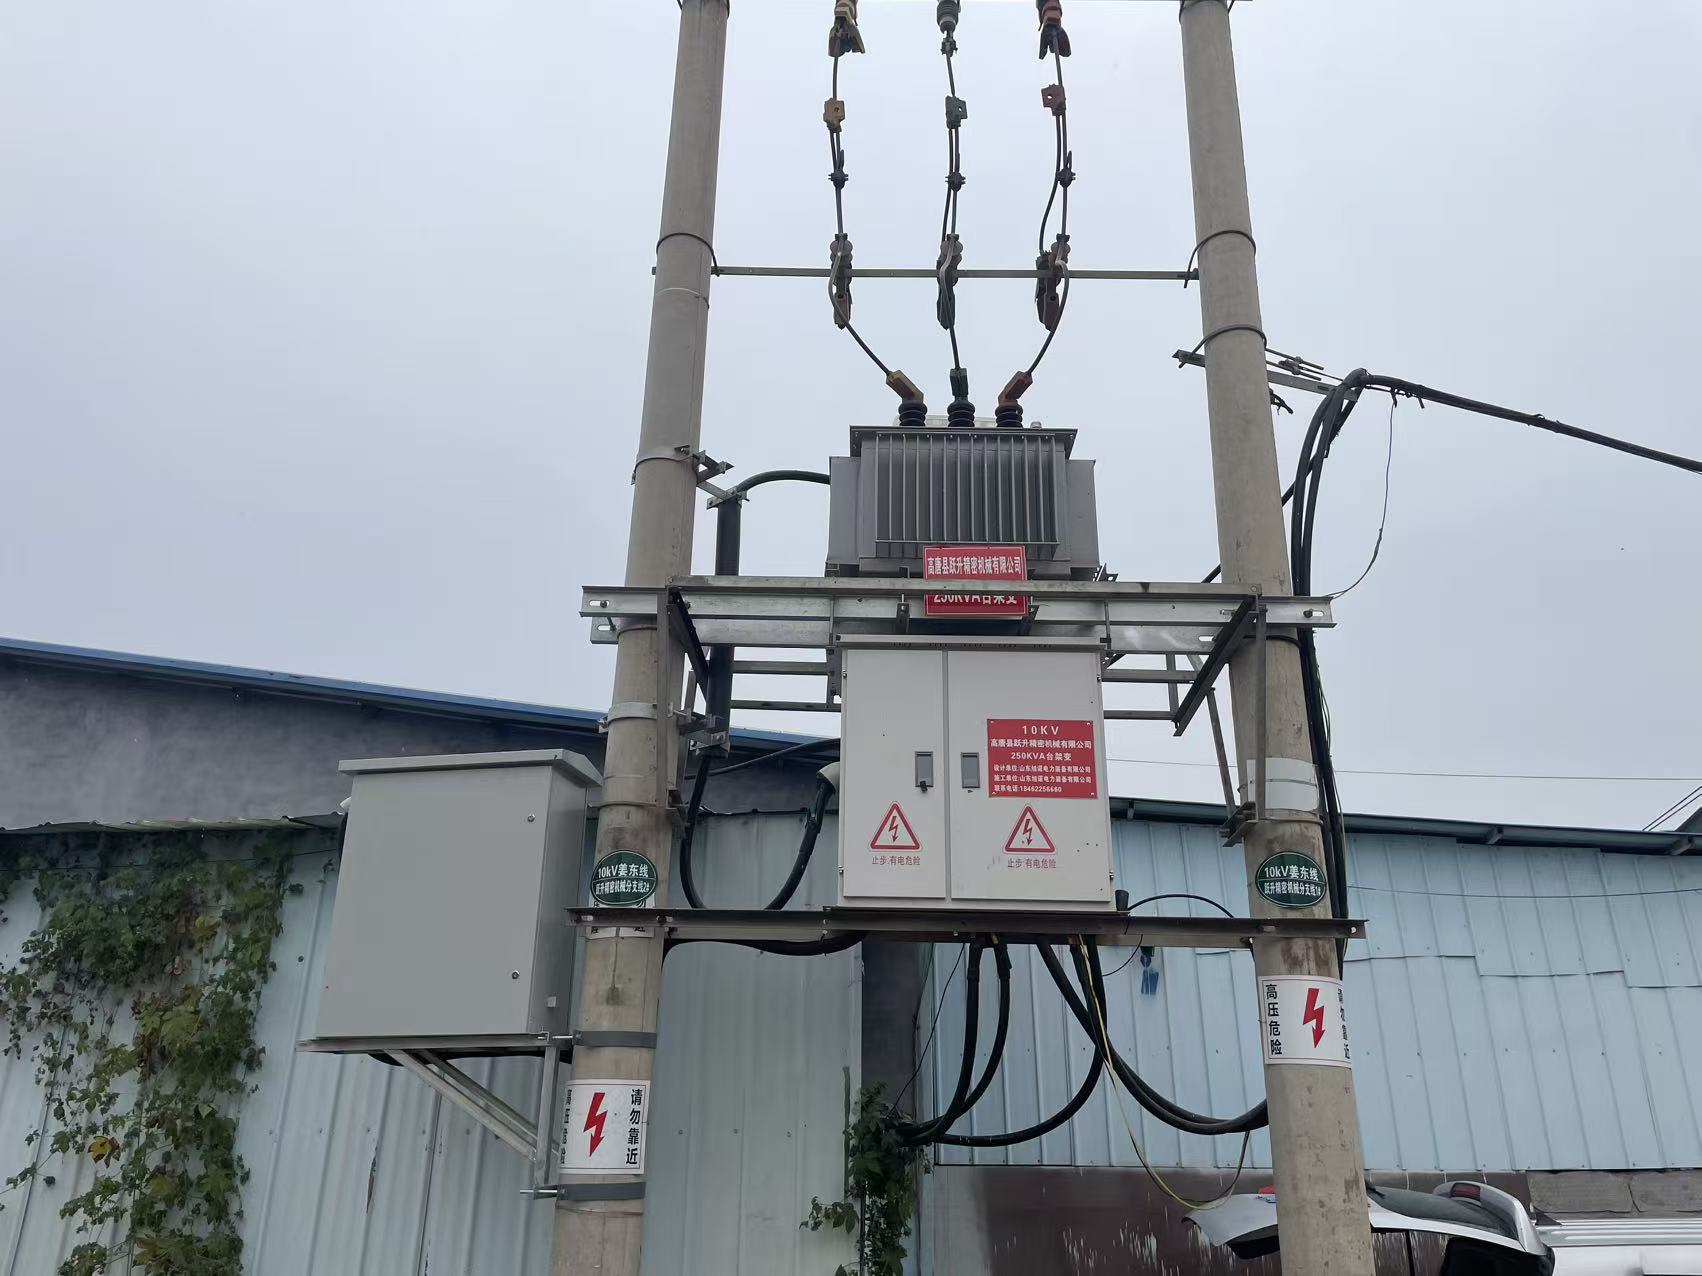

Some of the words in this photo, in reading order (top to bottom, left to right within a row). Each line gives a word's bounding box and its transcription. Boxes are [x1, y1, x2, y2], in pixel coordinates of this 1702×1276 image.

[927, 556, 1021, 575] 高唐县跃升精密机械有限公司
[1022, 725, 1060, 736] 10KV
[990, 738, 1092, 750] 高唐县跃升精密机械有限公司
[1011, 752, 1072, 762] 250KVA台架变
[597, 863, 649, 878] 10kV姜东线
[1264, 864, 1319, 881] 10kV姜东线
[1265, 983, 1282, 1055] 高压危险
[625, 1088, 643, 1165] 请勿靠近
